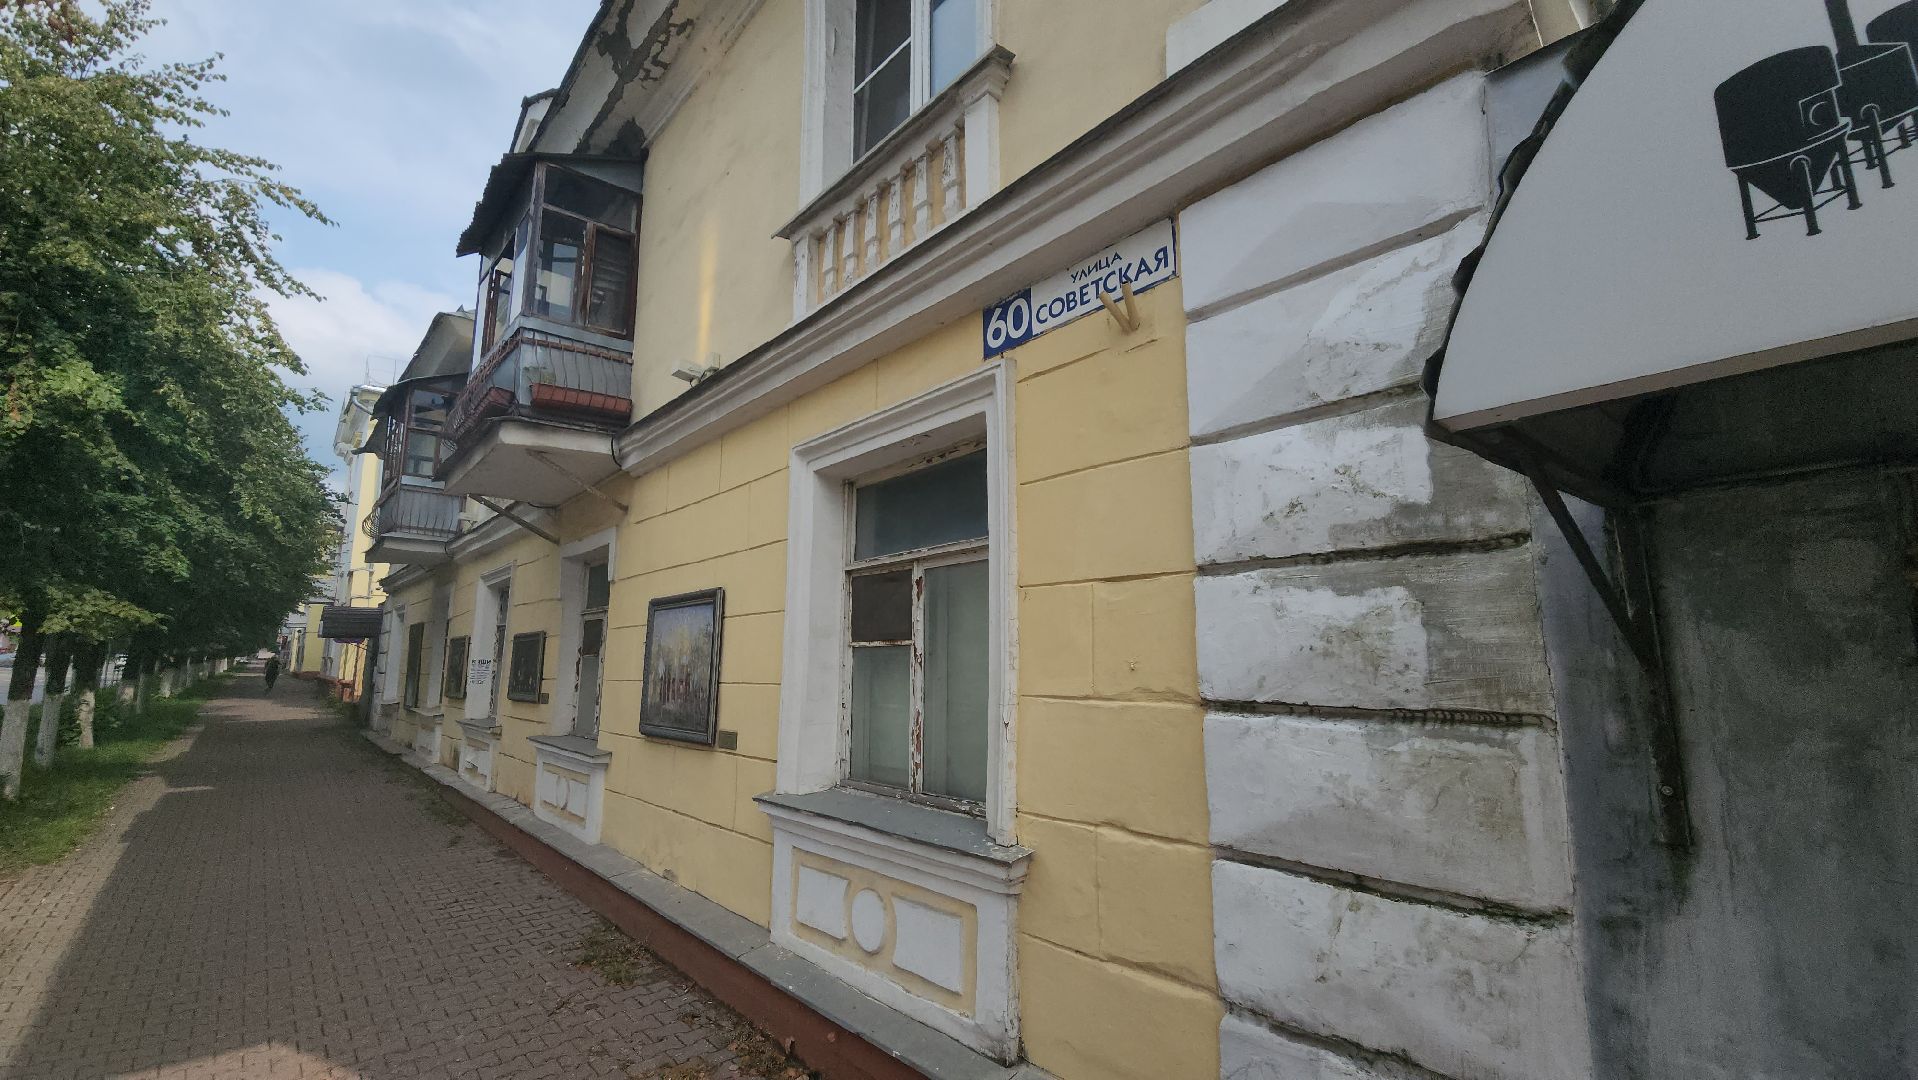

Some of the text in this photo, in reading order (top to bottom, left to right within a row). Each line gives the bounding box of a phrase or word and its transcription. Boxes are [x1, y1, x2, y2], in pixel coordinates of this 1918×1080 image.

[1035, 245, 1169, 324] СОВЕТСКАЯ
[1070, 251, 1122, 283] УЛИЦА
[986, 297, 1030, 349] 60
